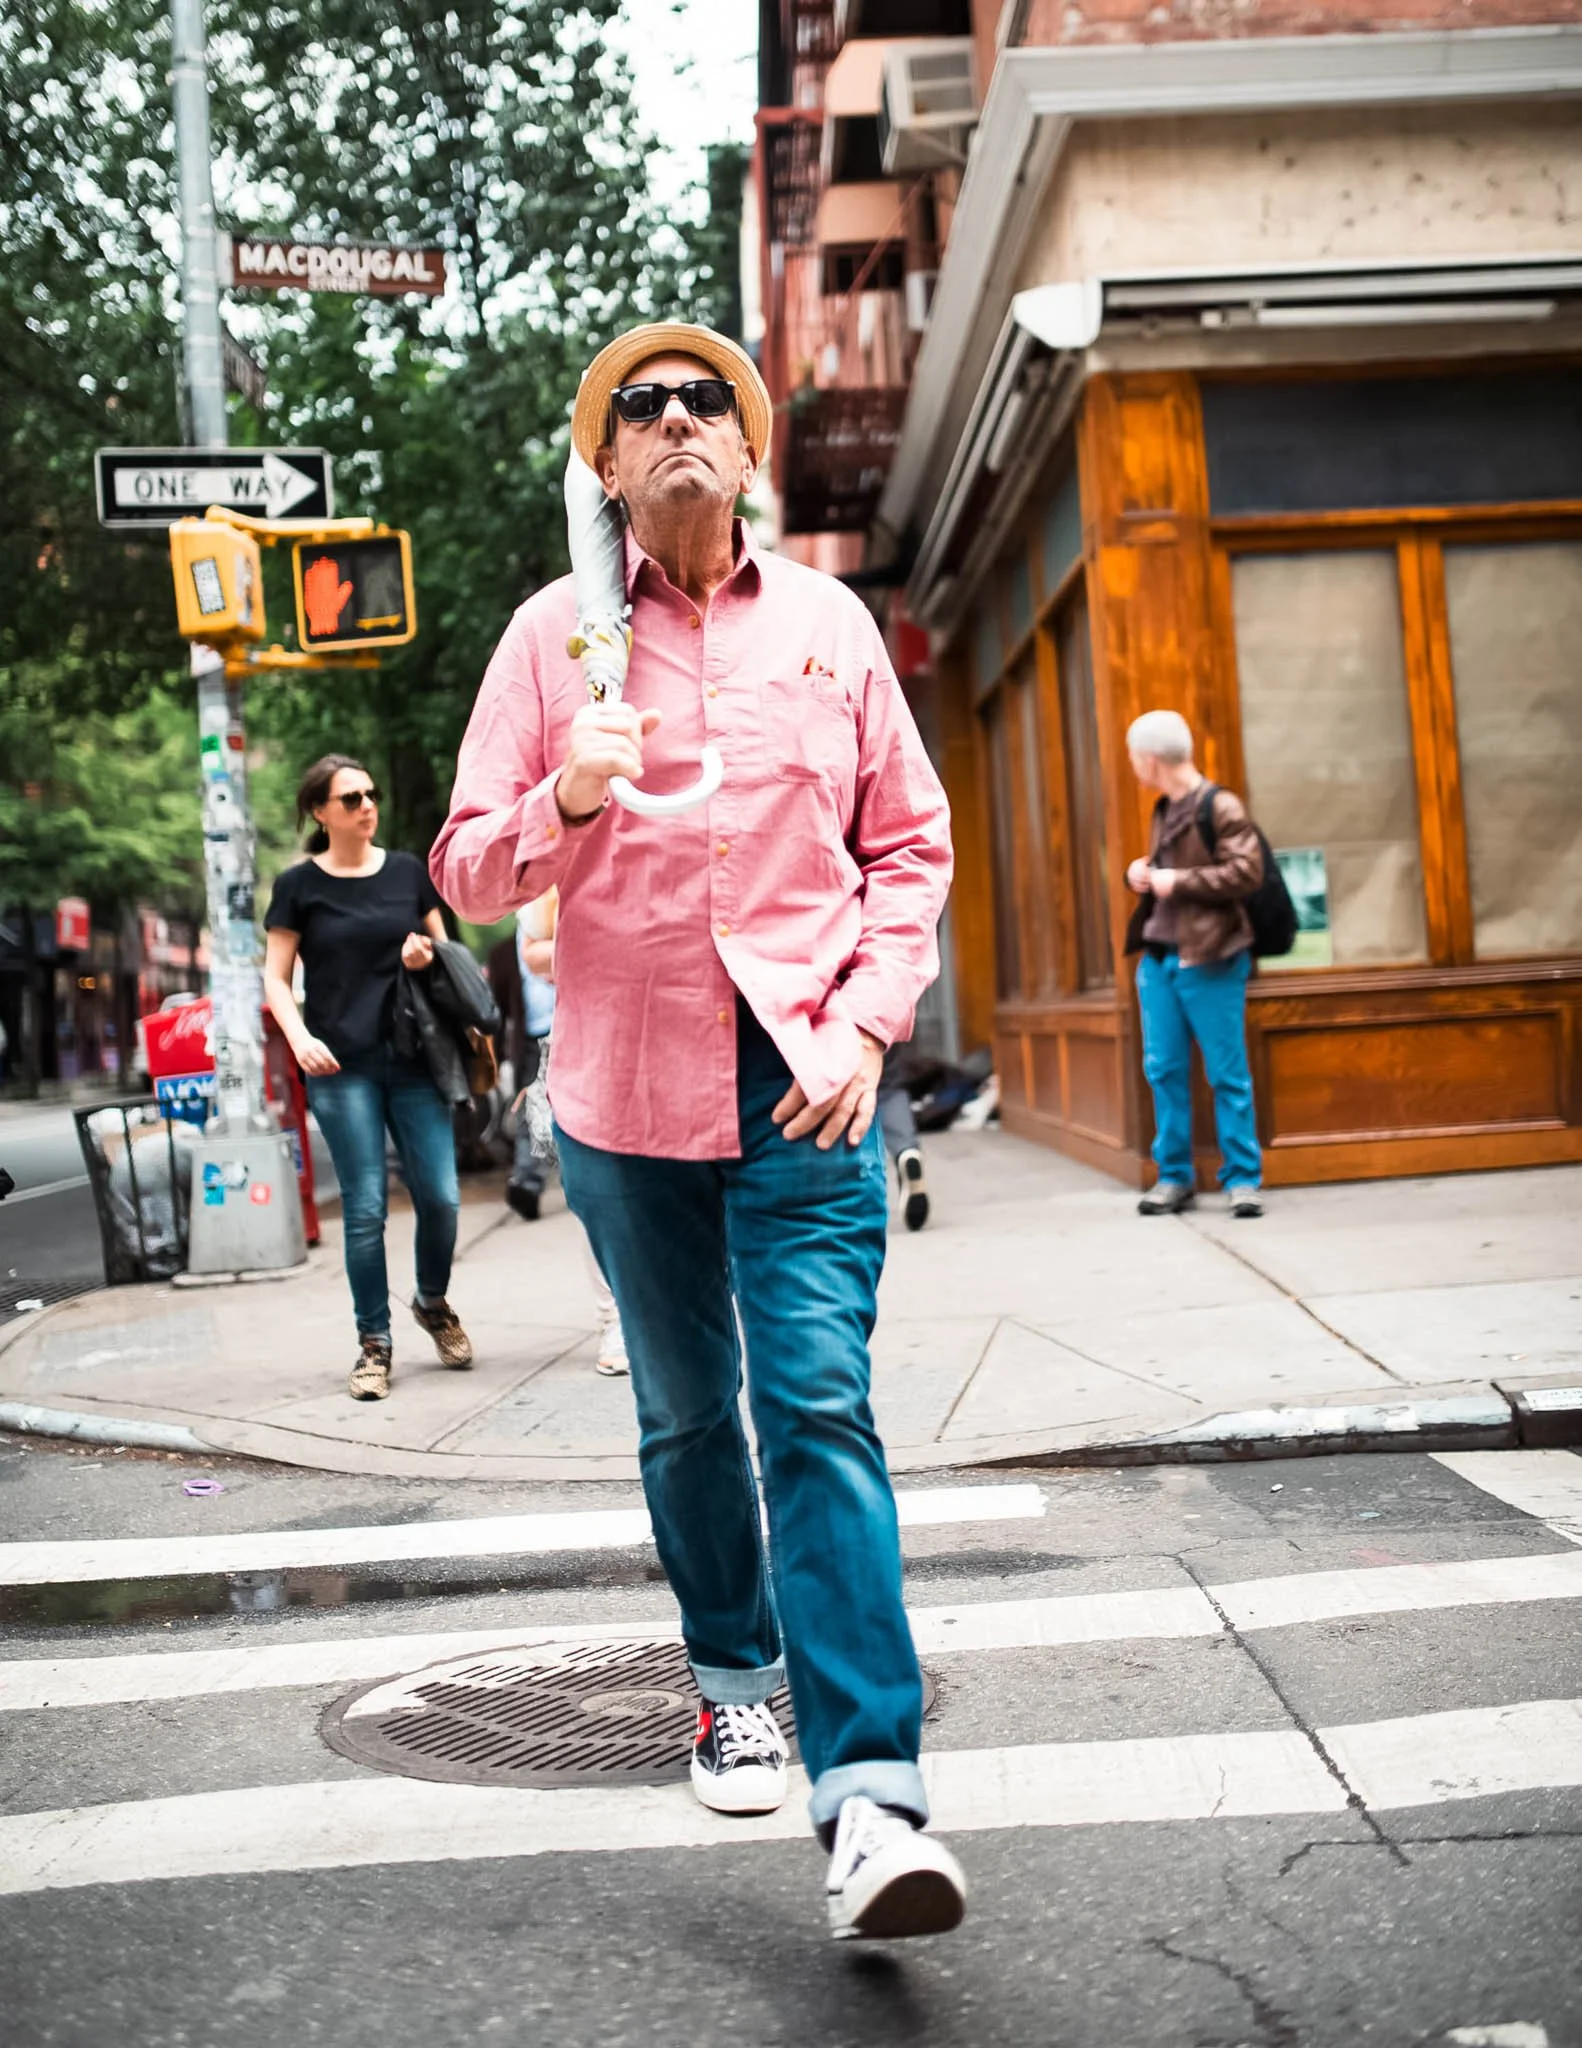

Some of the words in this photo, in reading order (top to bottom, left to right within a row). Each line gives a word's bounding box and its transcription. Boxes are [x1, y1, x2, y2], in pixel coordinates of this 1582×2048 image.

[238, 242, 435, 282] MACDOUGAL
[134, 470, 197, 502] ONE
[229, 474, 292, 501] WAY
